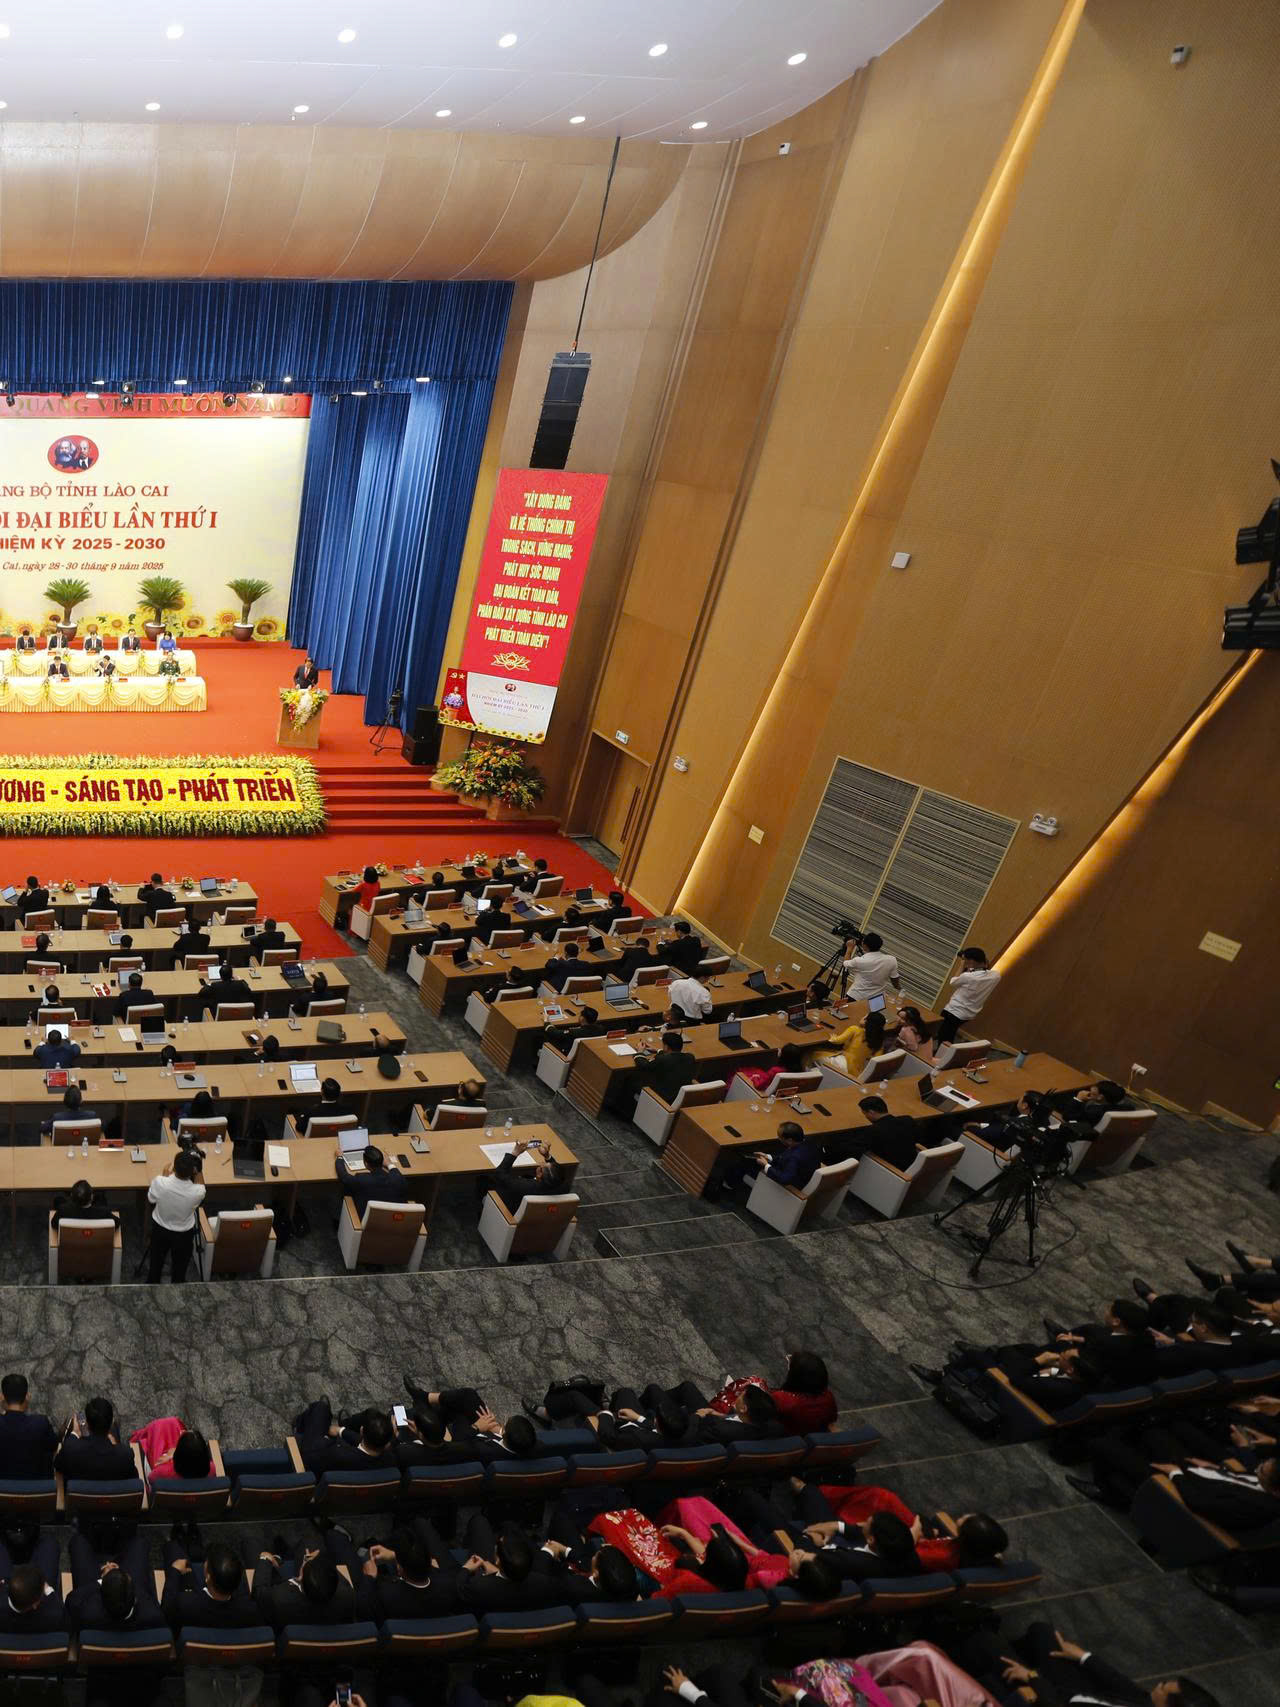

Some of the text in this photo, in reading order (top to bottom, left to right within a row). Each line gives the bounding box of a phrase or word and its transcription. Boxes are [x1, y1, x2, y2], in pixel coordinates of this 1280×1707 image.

[98, 398, 152, 411] VIH
[30, 482, 52, 499] BỘ
[56, 480, 97, 496] TỈNH
[104, 482, 136, 496] LÀO
[141, 486, 168, 496] CAI
[16, 512, 52, 531] ĐẠI
[58, 502, 108, 528] BIỂU
[113, 502, 155, 528] LẦN
[160, 505, 206, 528] THỨ
[209, 512, 218, 528] I
[41, 535, 66, 550] KỲ
[72, 538, 112, 550] 2025
[124, 538, 166, 550] 2030
[22, 562, 46, 572] ngày
[80, 562, 108, 572] tháng
[110, 562, 116, 570] 9
[118, 562, 139, 570] năm
[141, 562, 164, 570] 2025
[556, 614, 568, 628] CAI
[66, 776, 120, 802] SÁNG
[124, 778, 163, 806] TẠO
[179, 772, 230, 802] PHÁT
[233, 770, 297, 802] TRIỂN
